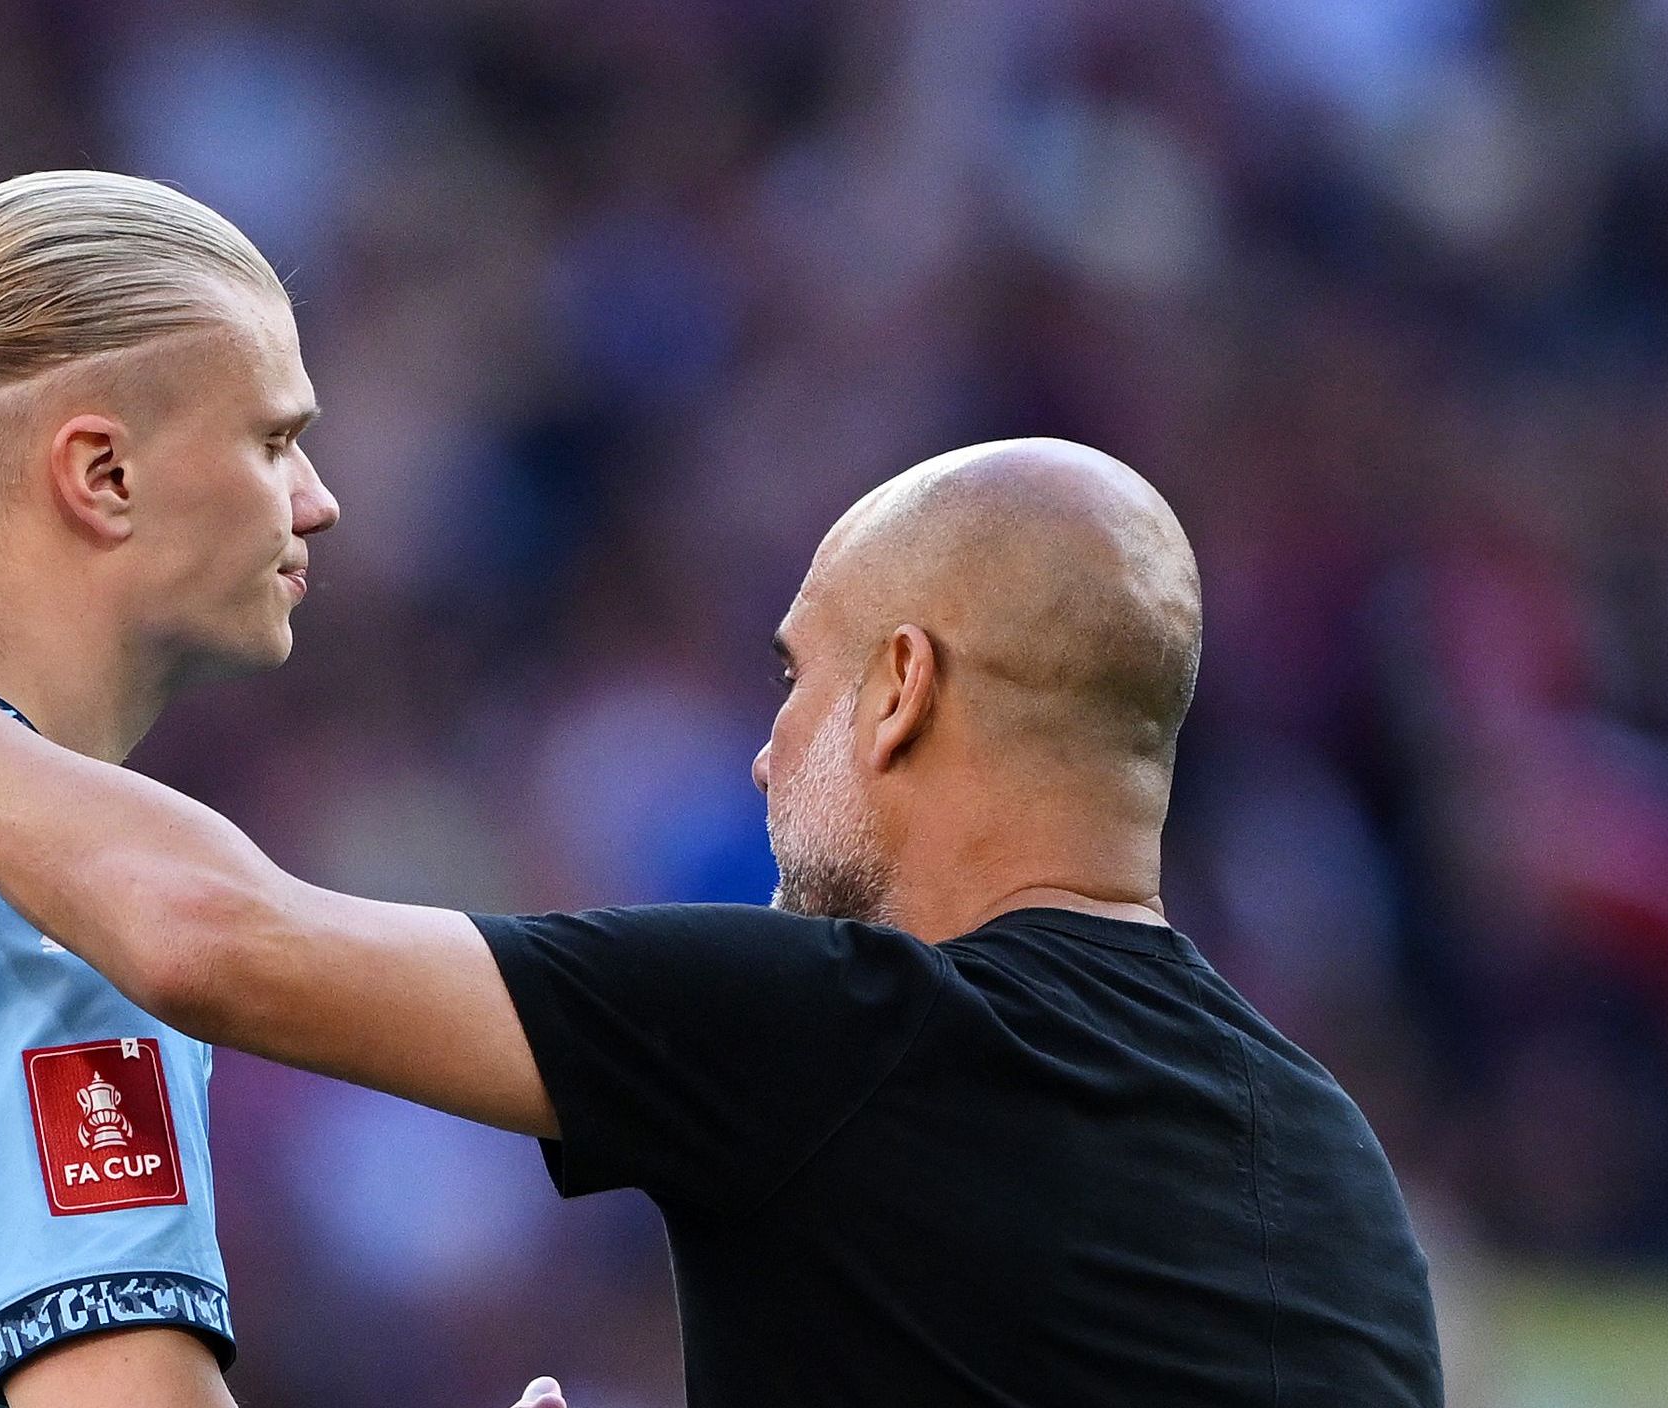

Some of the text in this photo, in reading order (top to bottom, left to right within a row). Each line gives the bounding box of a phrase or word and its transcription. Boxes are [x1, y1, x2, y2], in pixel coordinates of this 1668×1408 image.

[125, 1042, 133, 1052] 7
[64, 1154, 161, 1186] FA CUP
